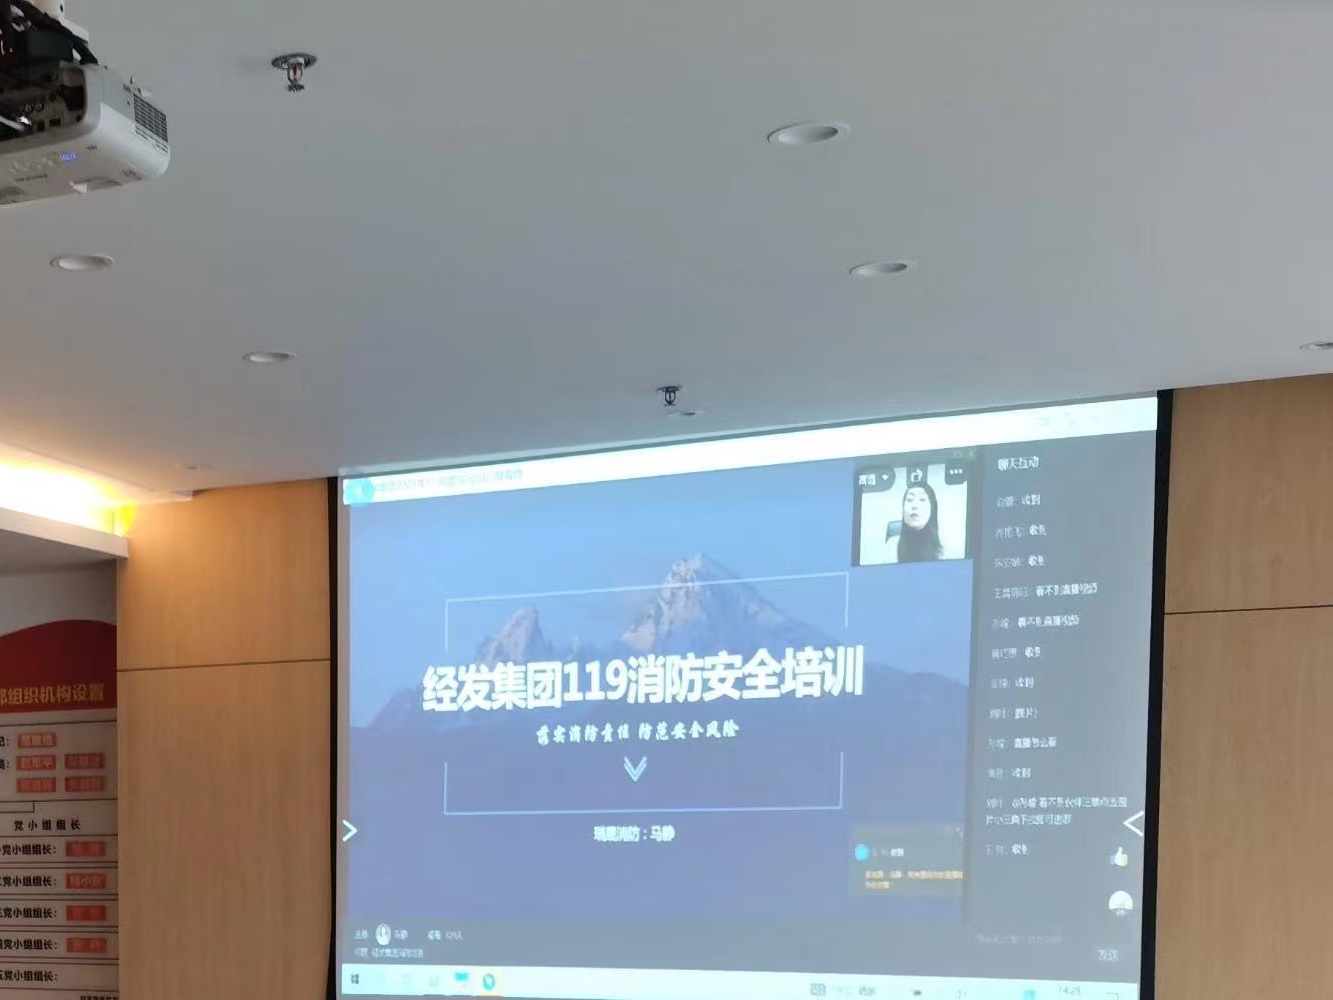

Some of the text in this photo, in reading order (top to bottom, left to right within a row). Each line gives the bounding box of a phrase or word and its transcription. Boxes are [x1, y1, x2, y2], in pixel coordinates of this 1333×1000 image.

[422, 645, 864, 712] 经发集团119消防安全培训
[536, 719, 740, 746] 落实消防责任 防范安全风险
